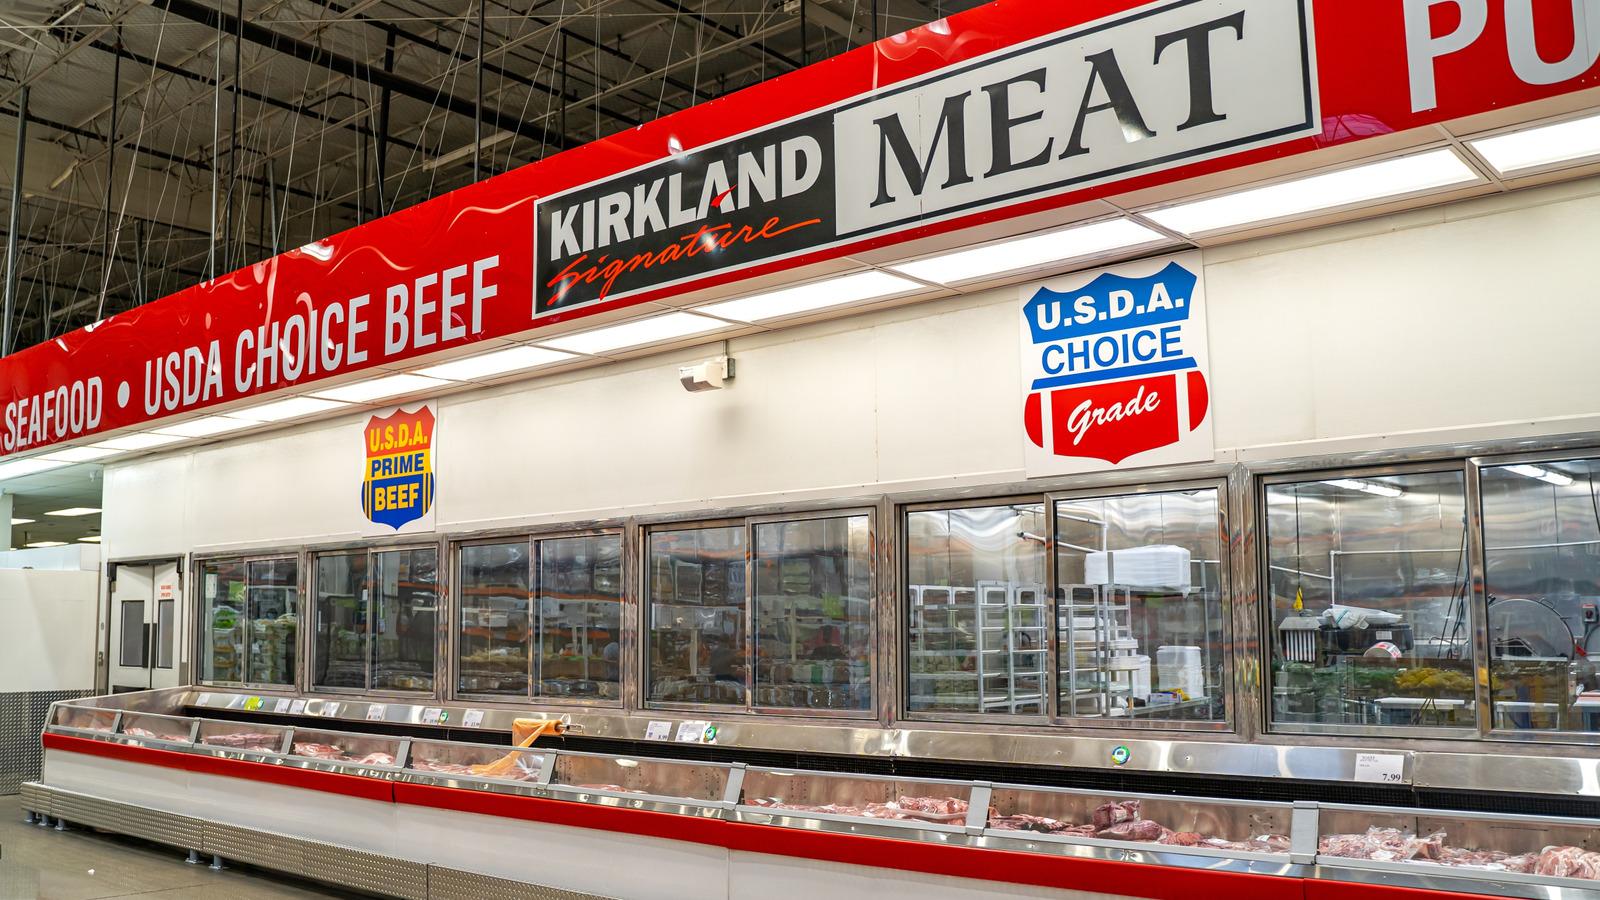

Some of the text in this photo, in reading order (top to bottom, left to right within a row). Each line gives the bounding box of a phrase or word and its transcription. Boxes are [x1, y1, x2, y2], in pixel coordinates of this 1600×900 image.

[870, 9, 1246, 208] MEAT
[551, 135, 823, 262] KIRKLAND
[547, 216, 821, 306] Signature
[1036, 282, 1185, 331] U.S.D.A.
[3, 254, 500, 451] SEAFOOD USDA CHOICE BEEF
[1041, 324, 1184, 375] CHOICE
[369, 420, 428, 453] U.S.D.A.
[1066, 384, 1161, 446] Grade
[371, 452, 425, 478] PRIME
[374, 482, 420, 512] BEEF
[1382, 773, 1401, 782] 7.99
